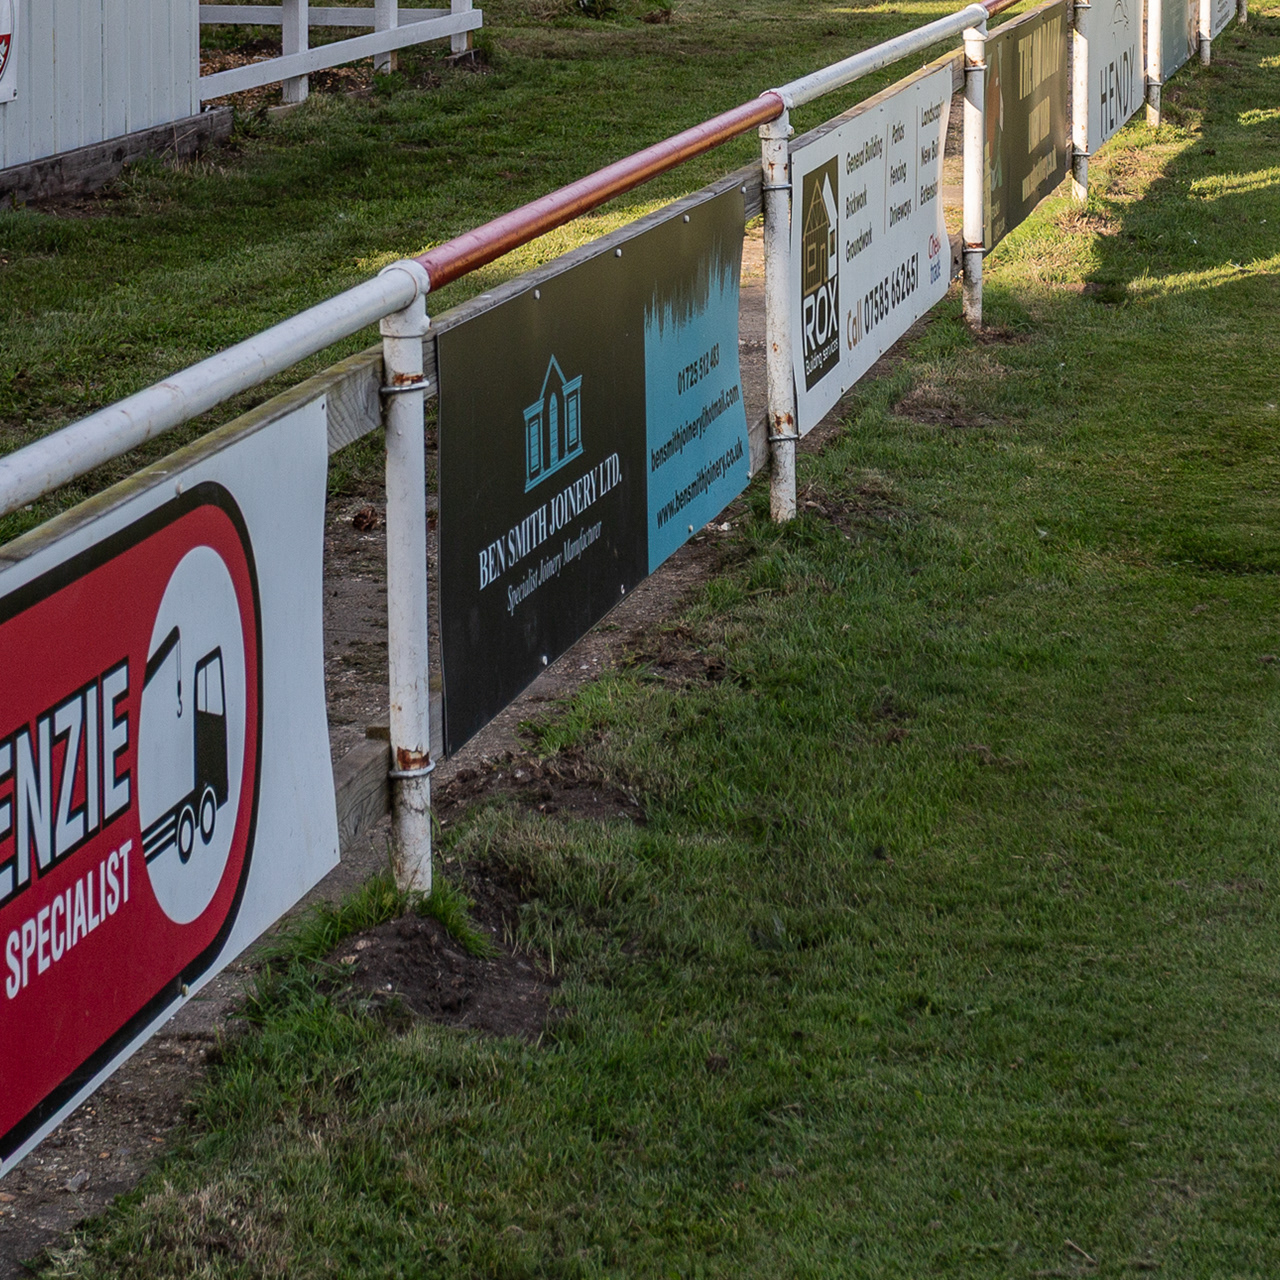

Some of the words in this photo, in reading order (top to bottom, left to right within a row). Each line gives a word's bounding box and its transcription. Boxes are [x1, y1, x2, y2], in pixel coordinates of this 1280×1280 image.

[1100, 43, 1135, 138] HENDY
[846, 142, 865, 175] General
[865, 134, 883, 163] Building
[891, 121, 905, 146] Patios
[920, 145, 931, 166] New
[890, 158, 907, 187] Fencing
[846, 183, 868, 219] Brickwork
[889, 198, 912, 228] Driveways
[846, 221, 873, 263] Groundwork
[803, 275, 838, 357] ROX
[846, 299, 863, 351] Call
[864, 276, 890, 334] 07585
[891, 252, 919, 309] 662651
[677, 360, 699, 396] 01725
[699, 350, 710, 381] 512
[805, 351, 823, 376] Building
[650, 384, 740, 473] bensmithjoinery@hotmail.com
[656, 435, 744, 530] www.bensmithjoinery.co.uk
[478, 535, 506, 591] BEN
[507, 504, 548, 569] SMITH
[549, 467, 598, 535] JOINERY
[599, 452, 623, 498] LTD.
[507, 568, 539, 617] Specialist
[538, 552, 563, 586] Joinery
[563, 520, 603, 566] Manufacturer
[5, 838, 133, 1001] SPECIALIST
